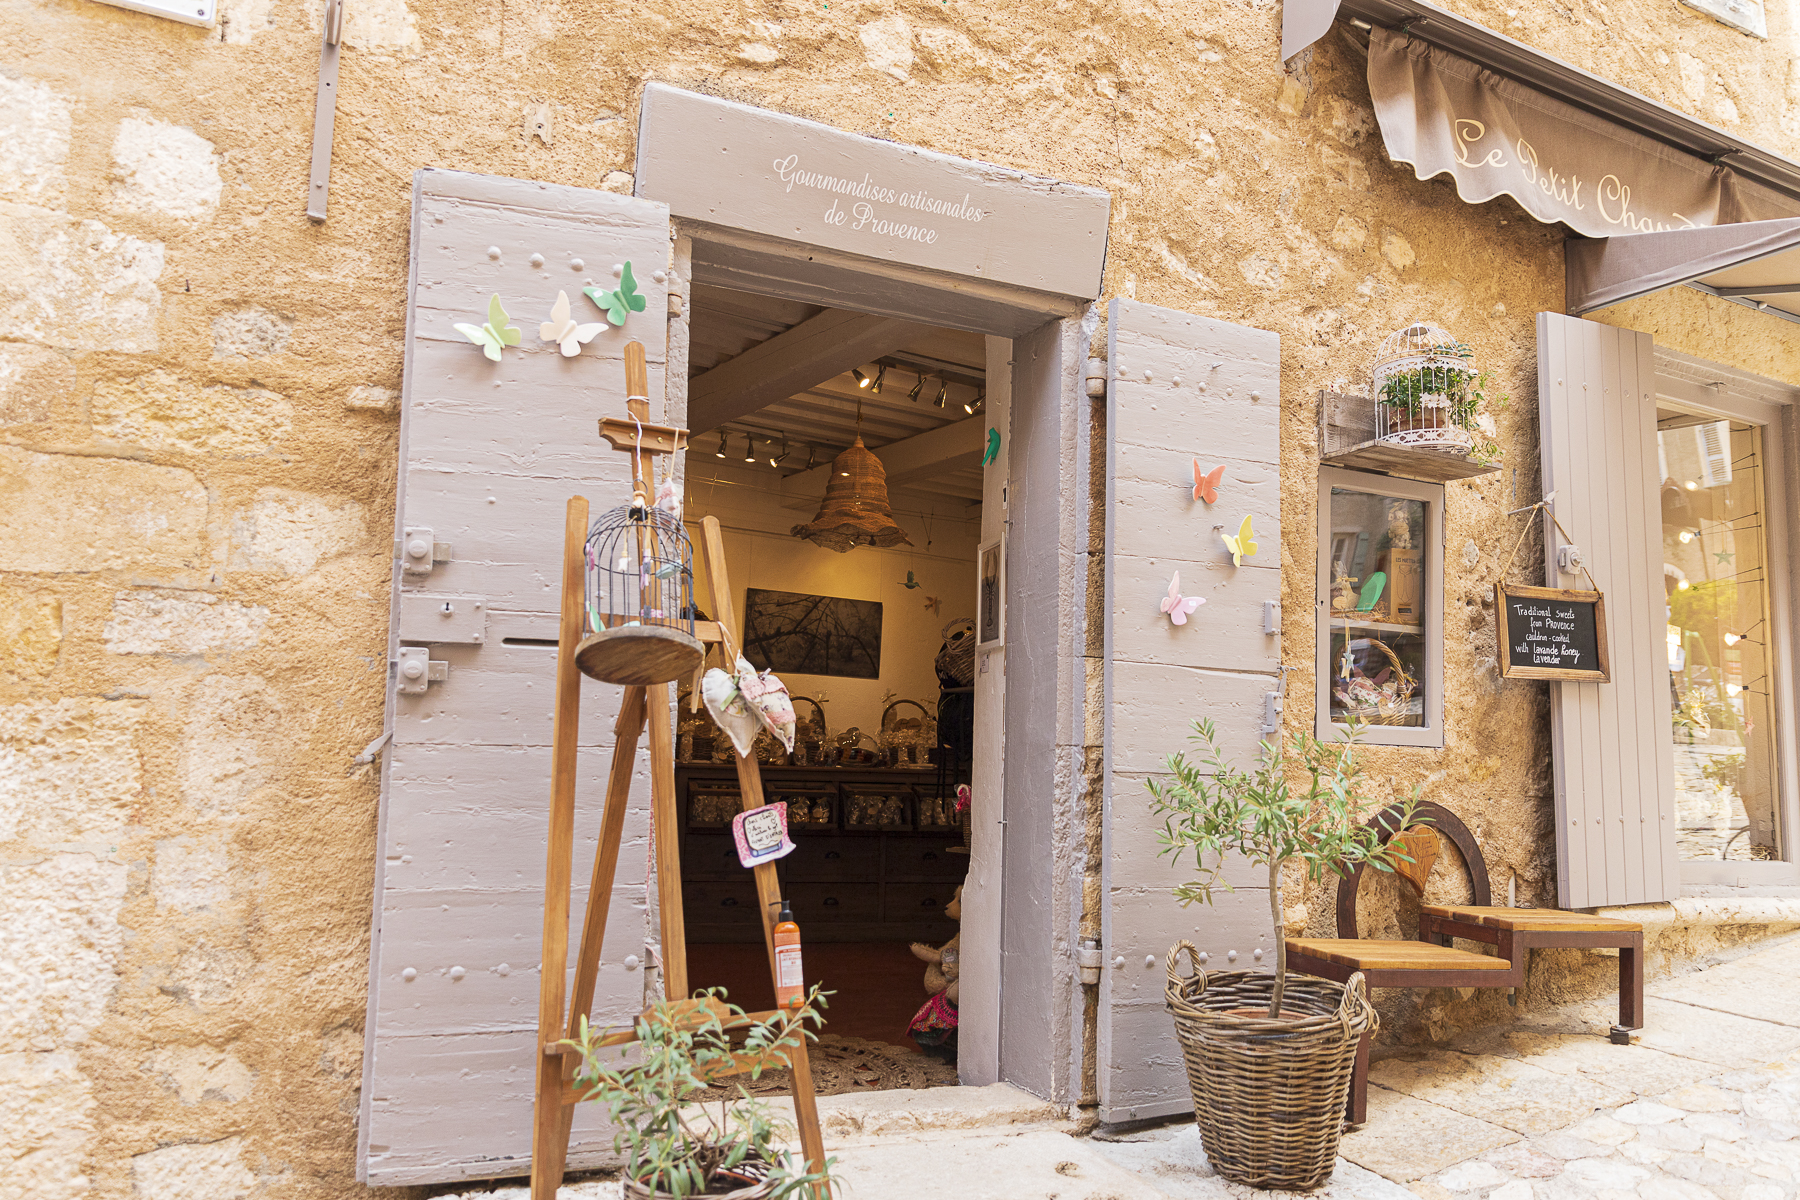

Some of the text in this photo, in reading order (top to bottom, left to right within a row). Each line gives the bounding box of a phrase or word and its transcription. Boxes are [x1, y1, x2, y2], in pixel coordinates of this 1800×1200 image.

[1453, 118, 1508, 168] Le
[1516, 138, 1584, 211] Petit
[773, 154, 984, 222] Gourmandises artisanales
[824, 199, 938, 244] de Provence
[1513, 604, 1551, 617] Traditional
[1530, 616, 1543, 632] from
[1515, 642, 1580, 665] with lavande honey
[1533, 653, 1561, 665] lavender
